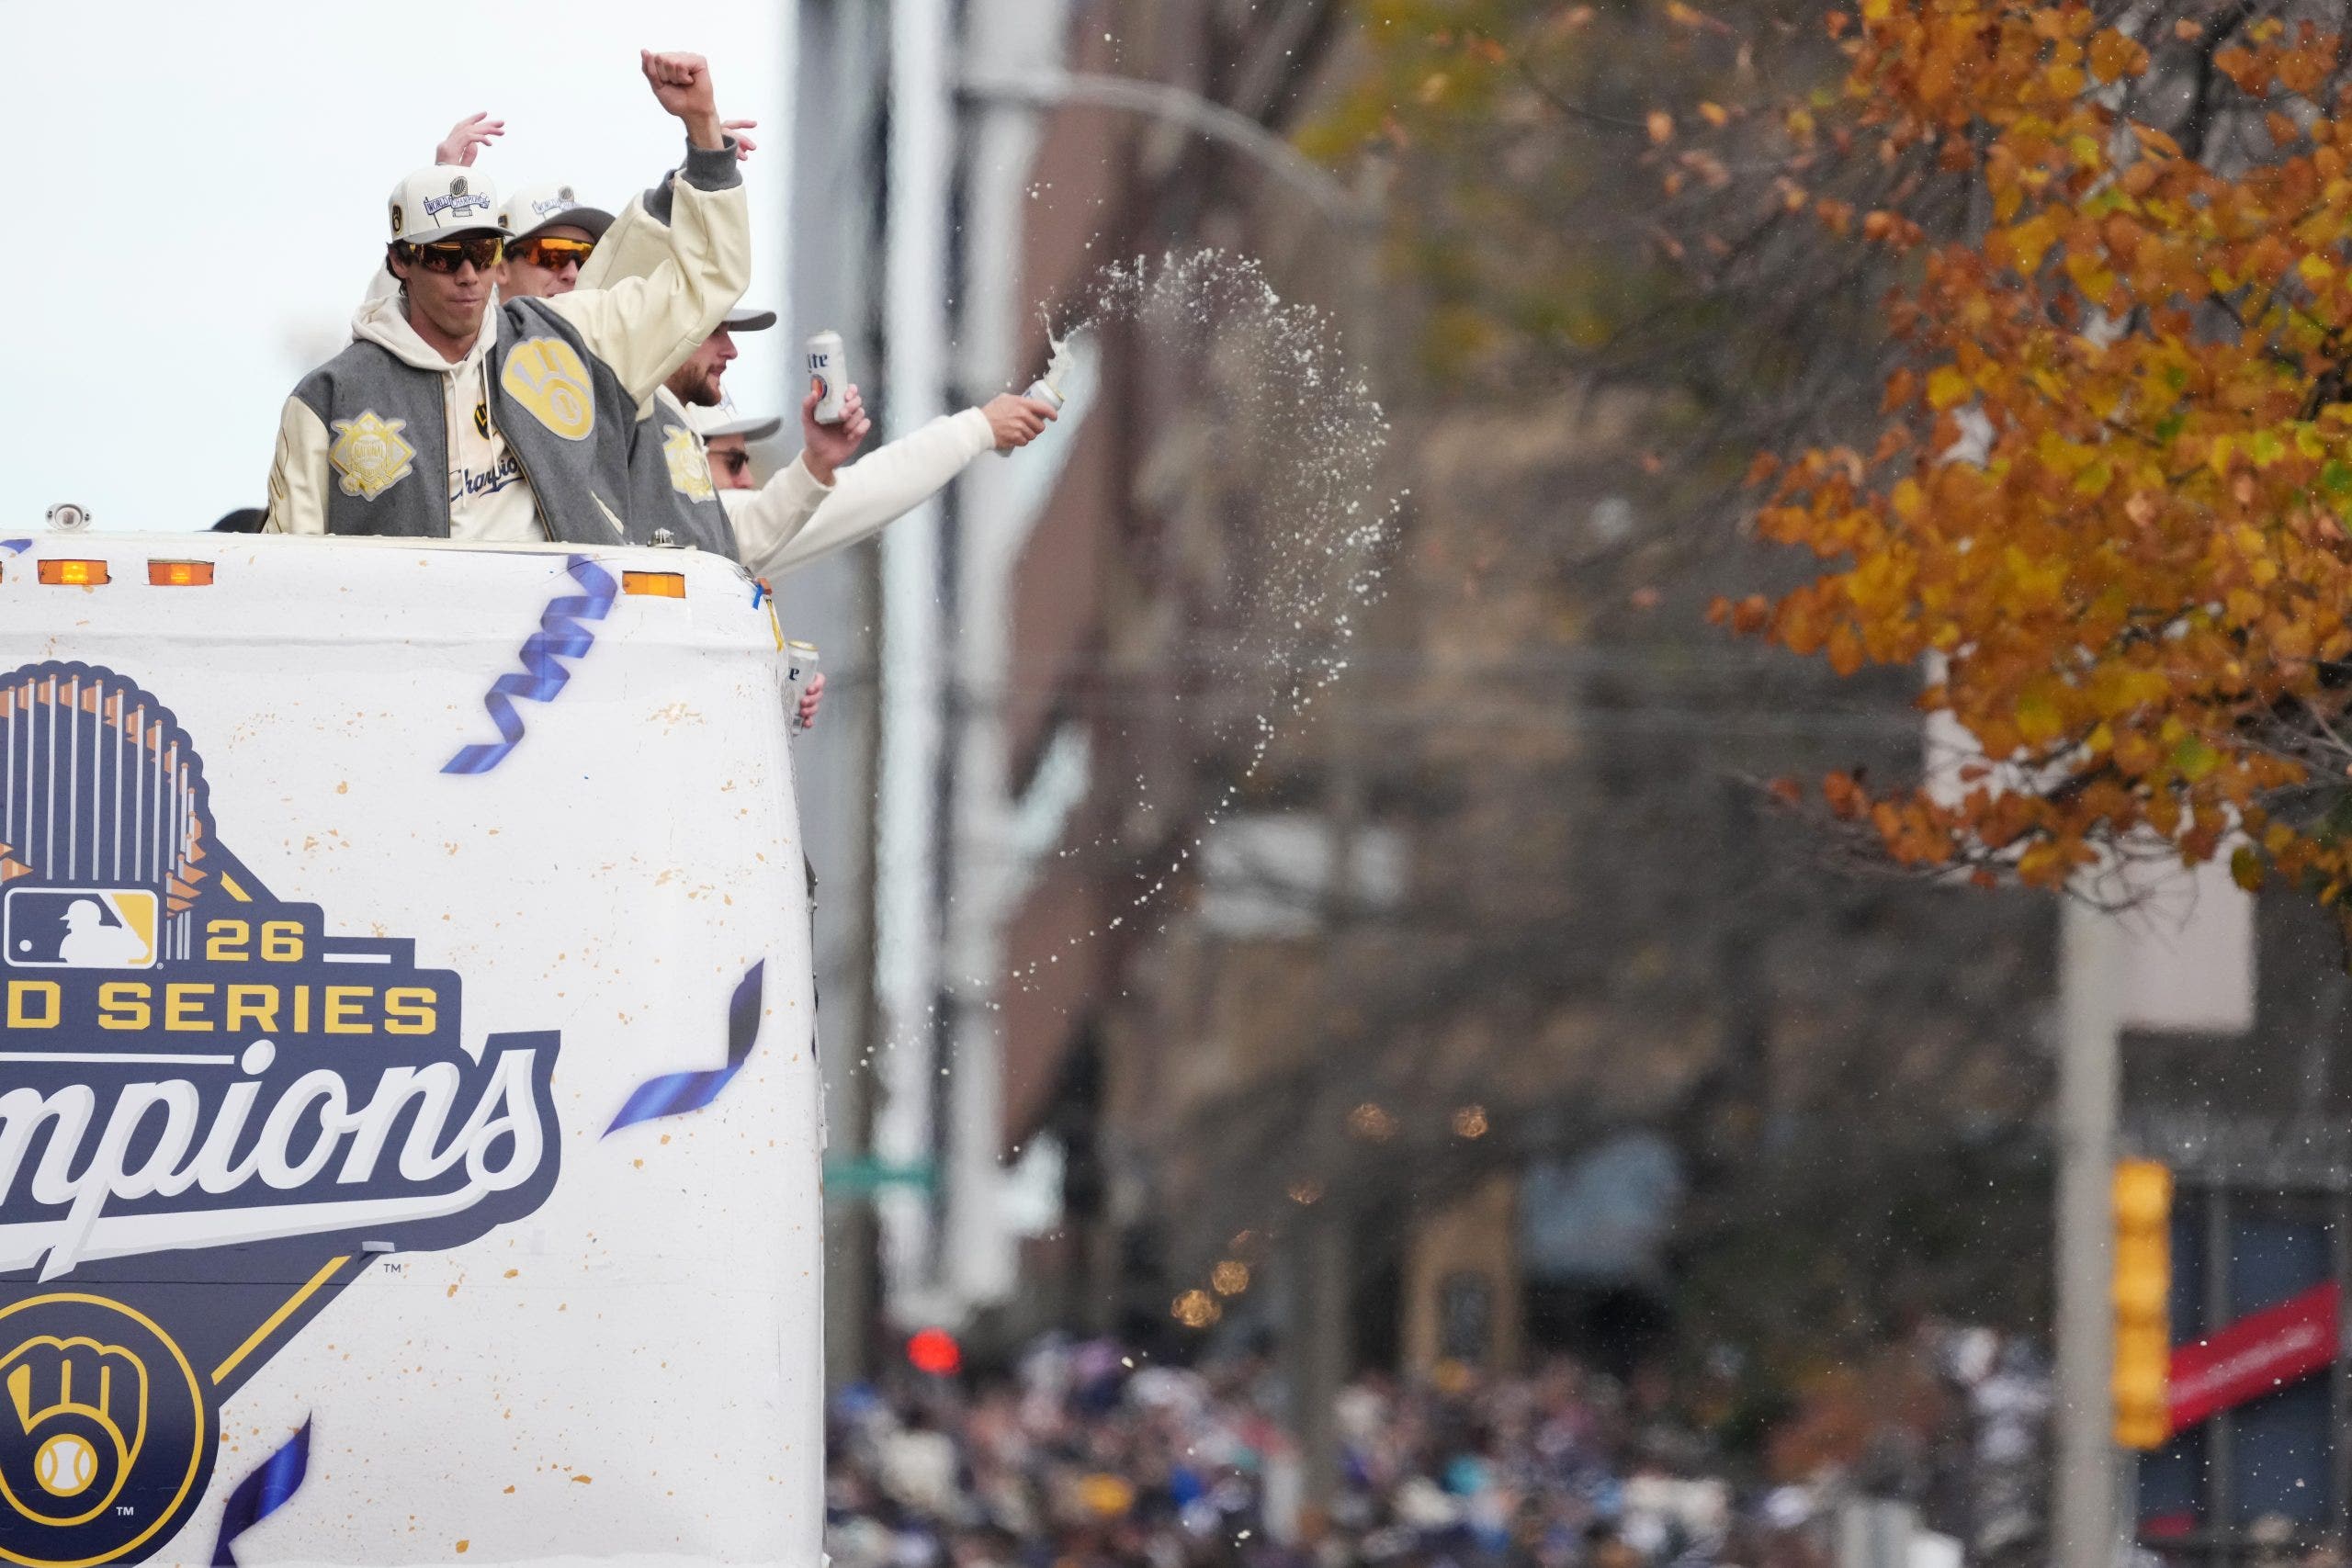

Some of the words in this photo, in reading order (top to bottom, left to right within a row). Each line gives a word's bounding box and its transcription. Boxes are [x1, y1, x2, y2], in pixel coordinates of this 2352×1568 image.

[426, 197, 449, 212] WORLD
[206, 919, 304, 963] 26
[6, 980, 61, 1029] D
[98, 982, 437, 1034] SERIES
[383, 1263, 401, 1273] TM
[116, 1506, 134, 1516] TM
